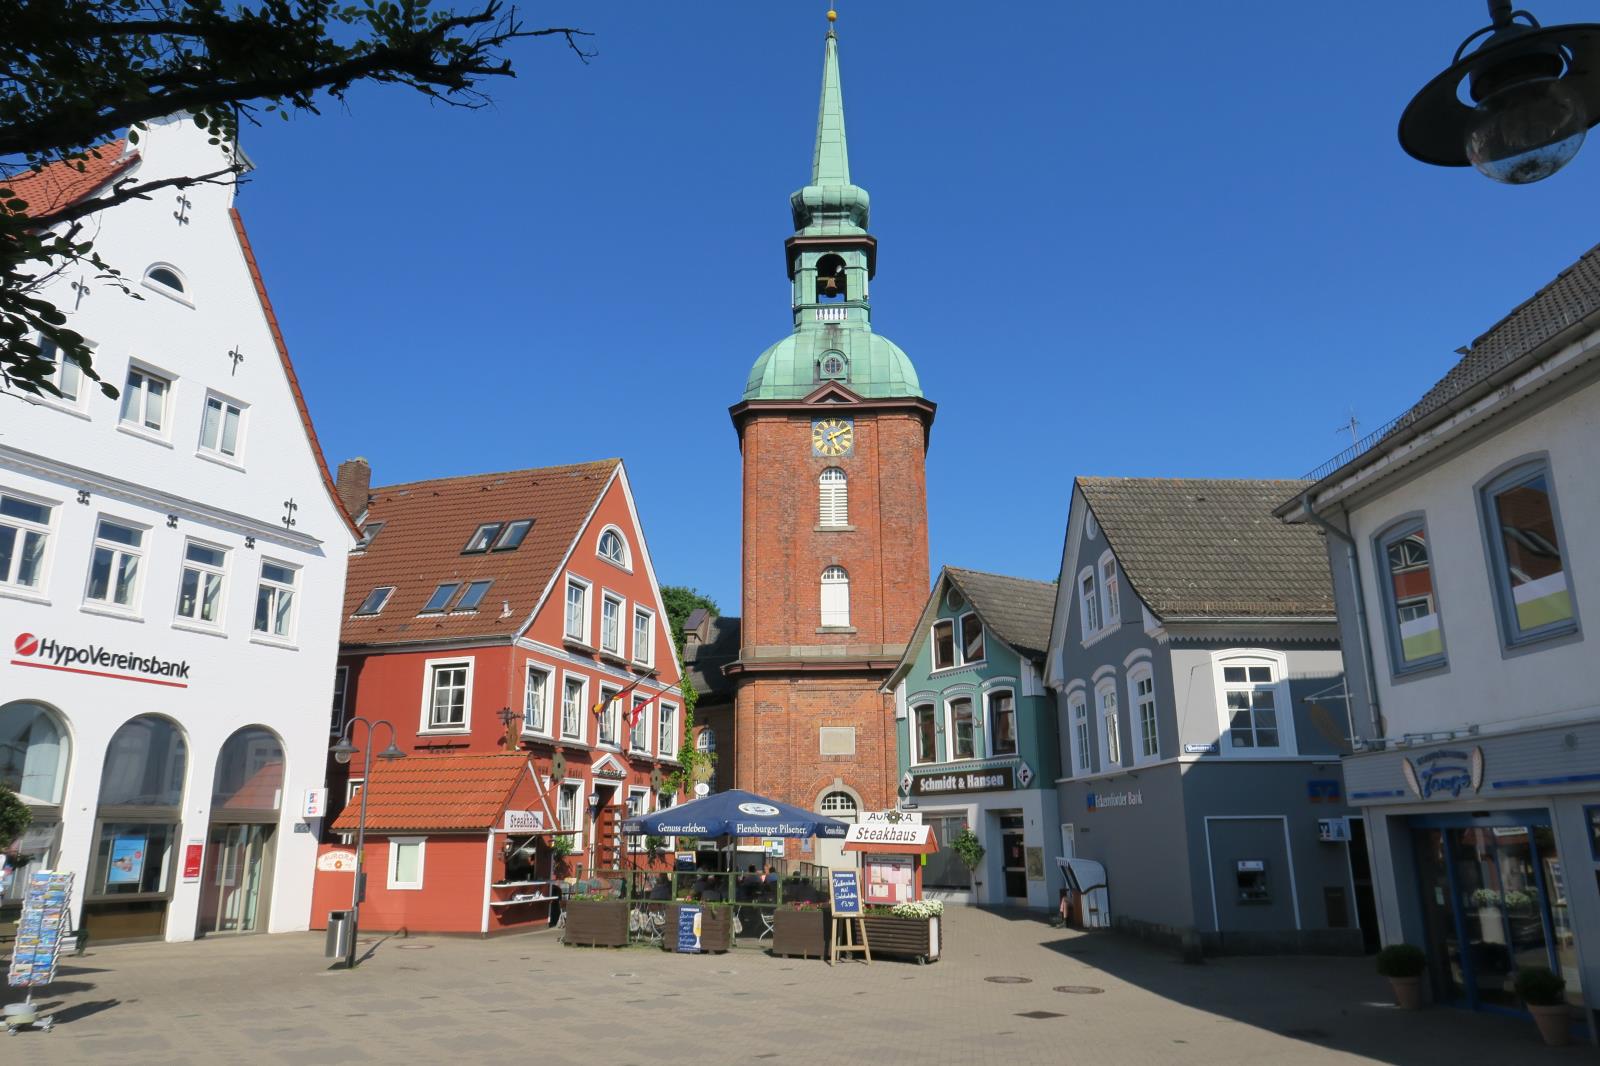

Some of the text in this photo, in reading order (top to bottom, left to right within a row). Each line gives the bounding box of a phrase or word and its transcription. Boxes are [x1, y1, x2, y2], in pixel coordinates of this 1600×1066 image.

[39, 638, 190, 679] HypoVereinsbank
[920, 774, 1004, 792] Schmidt & Hansen
[1127, 788, 1143, 805] Bank
[868, 812, 912, 821] AURRA
[658, 823, 708, 833] Genuss erleben.
[736, 823, 807, 835] Flensburger Pilsener.
[856, 827, 917, 842] Steakhaus
